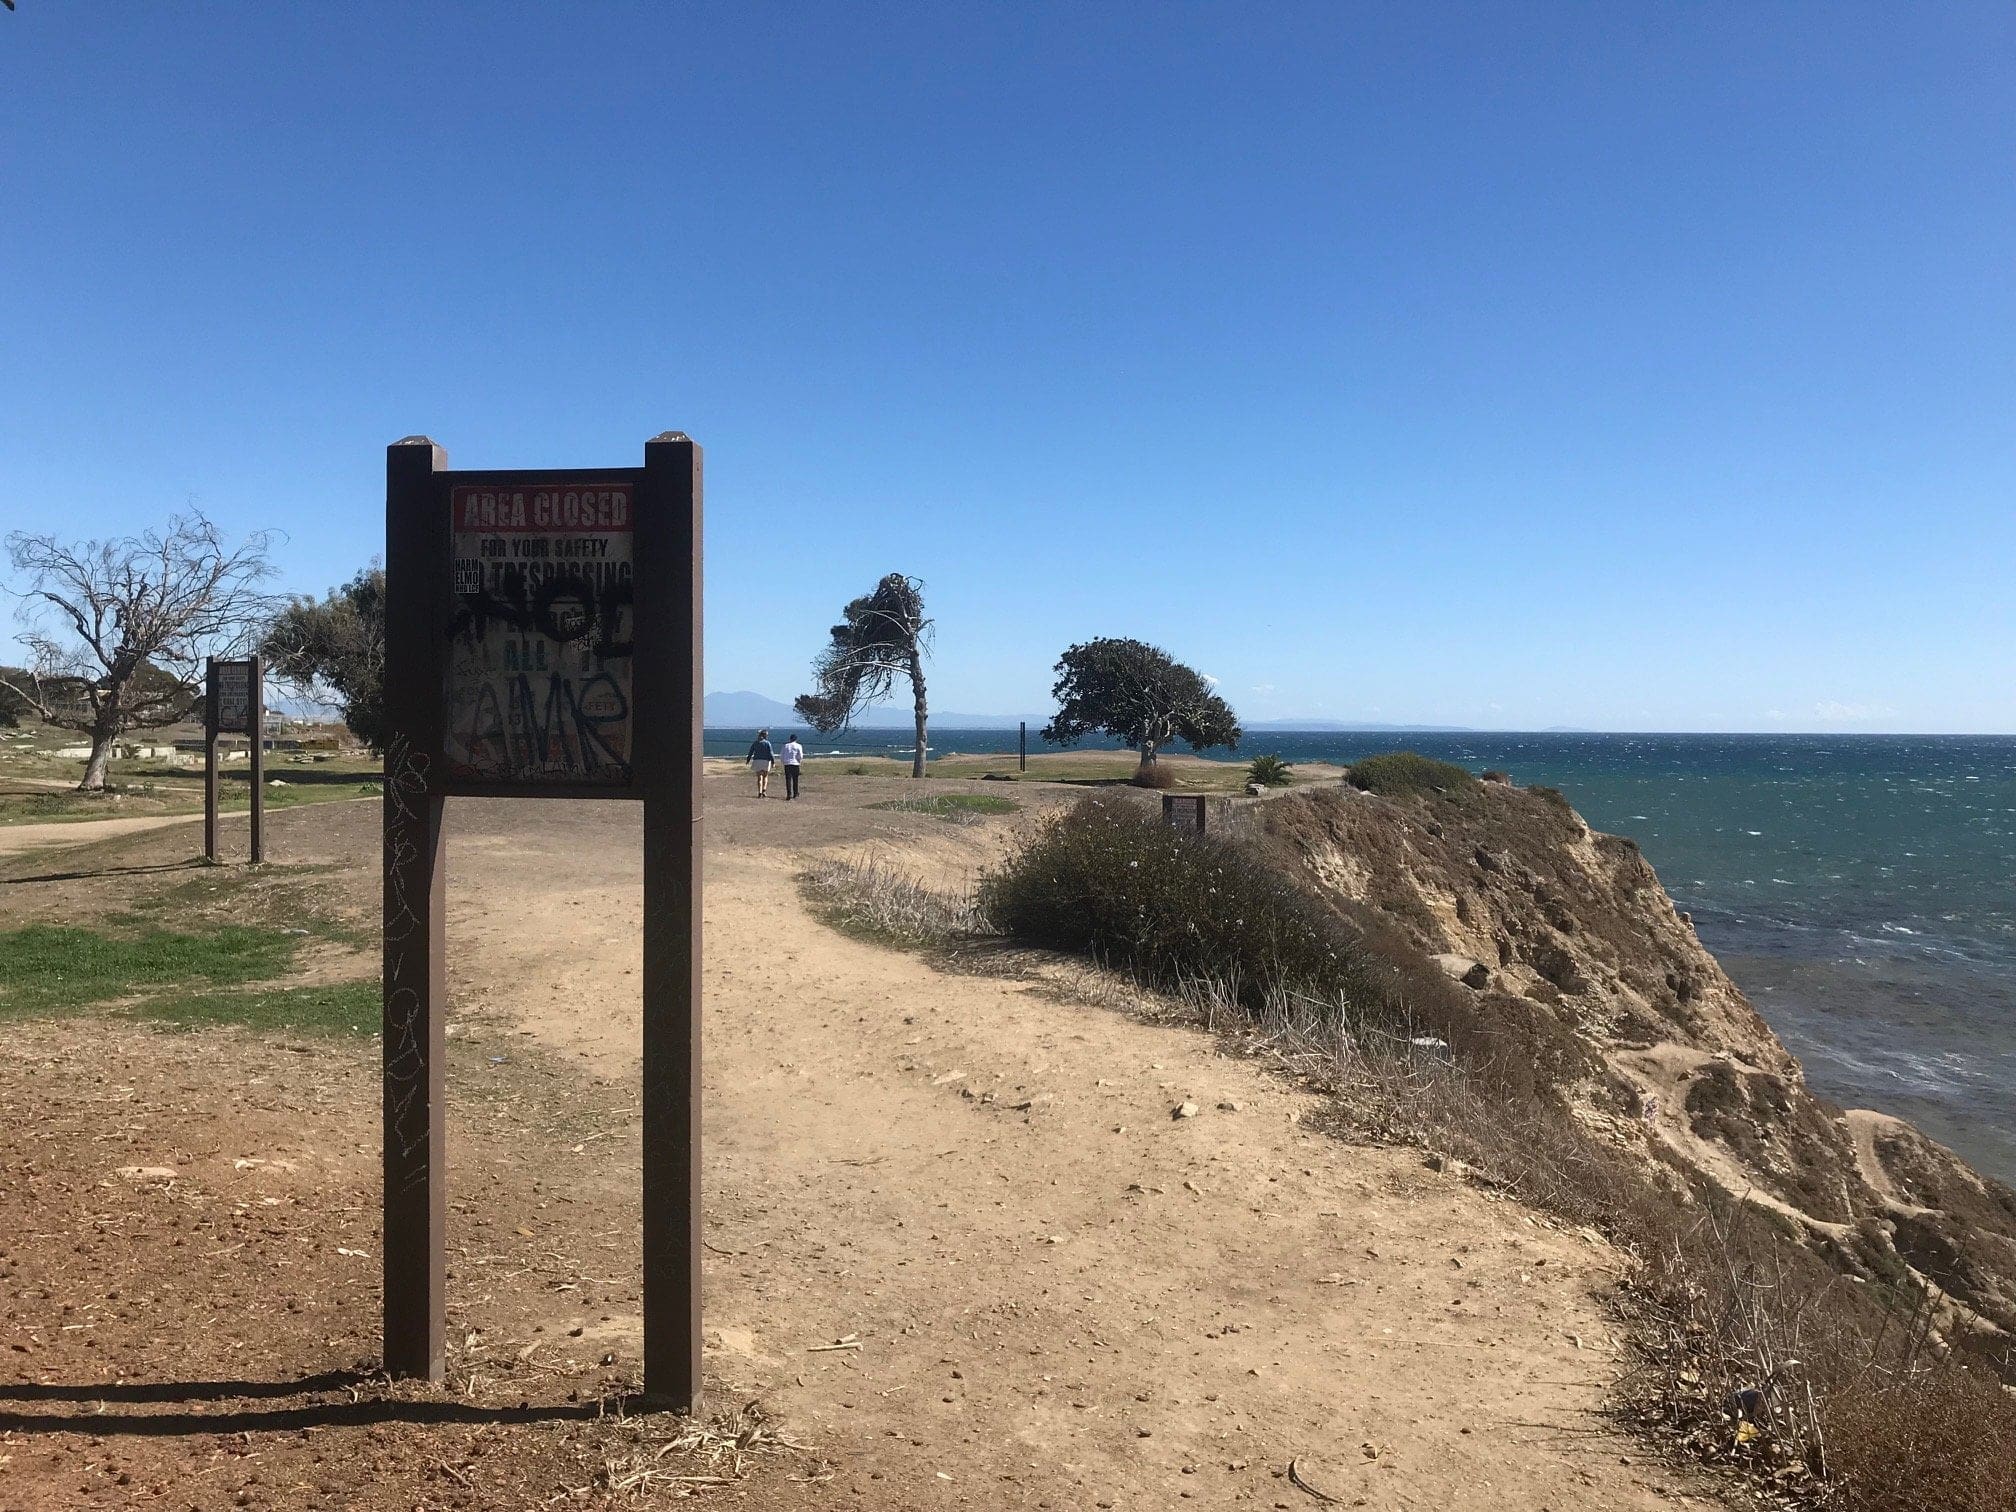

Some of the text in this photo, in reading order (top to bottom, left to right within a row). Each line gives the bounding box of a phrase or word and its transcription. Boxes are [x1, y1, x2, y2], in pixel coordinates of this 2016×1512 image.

[464, 491, 628, 527] AREA CLOSED
[480, 538, 609, 558] FOR YOUR SAFETY
[455, 572, 479, 585] ELMO
